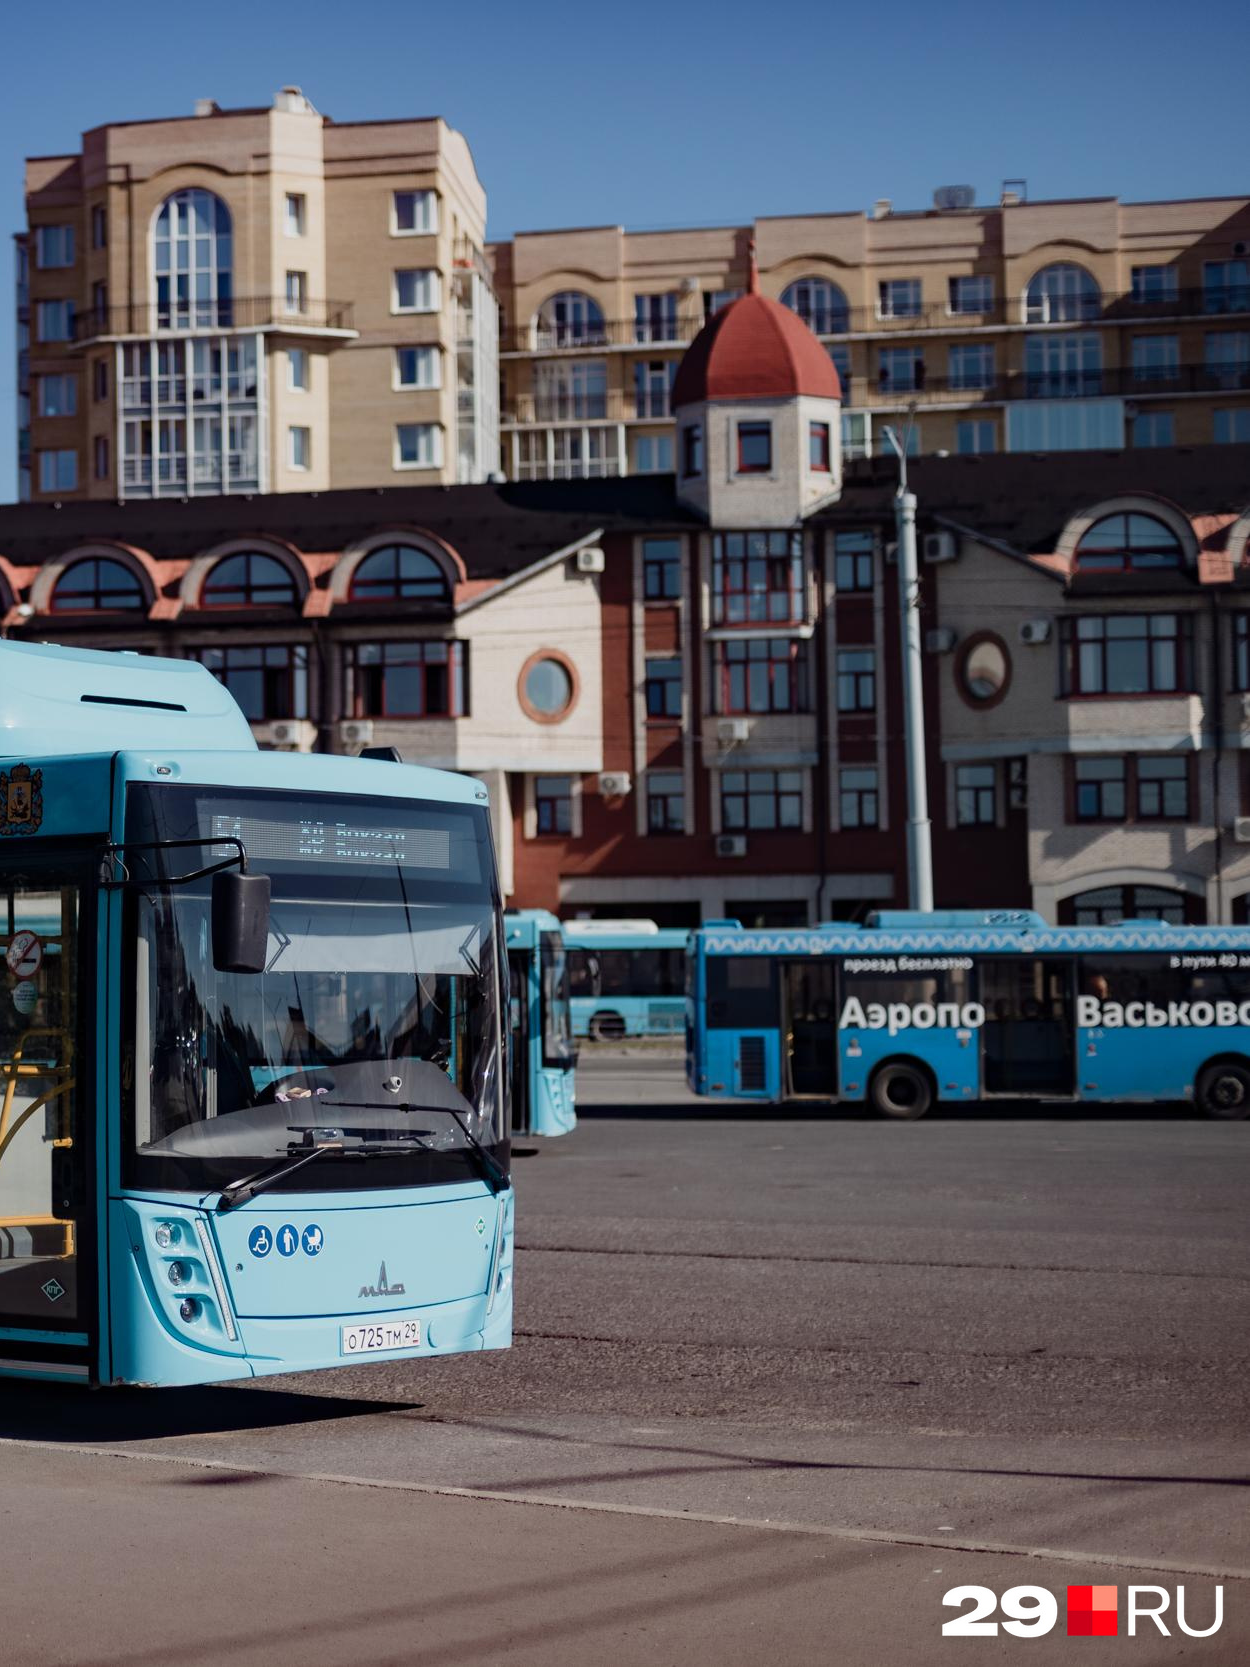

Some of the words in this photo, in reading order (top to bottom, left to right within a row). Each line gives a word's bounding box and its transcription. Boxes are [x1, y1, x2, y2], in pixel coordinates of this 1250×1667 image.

[843, 957, 897, 974] проезд
[897, 954, 974, 971] бесплатно
[1181, 955, 1217, 971] пути
[838, 995, 986, 1036] Аэропо
